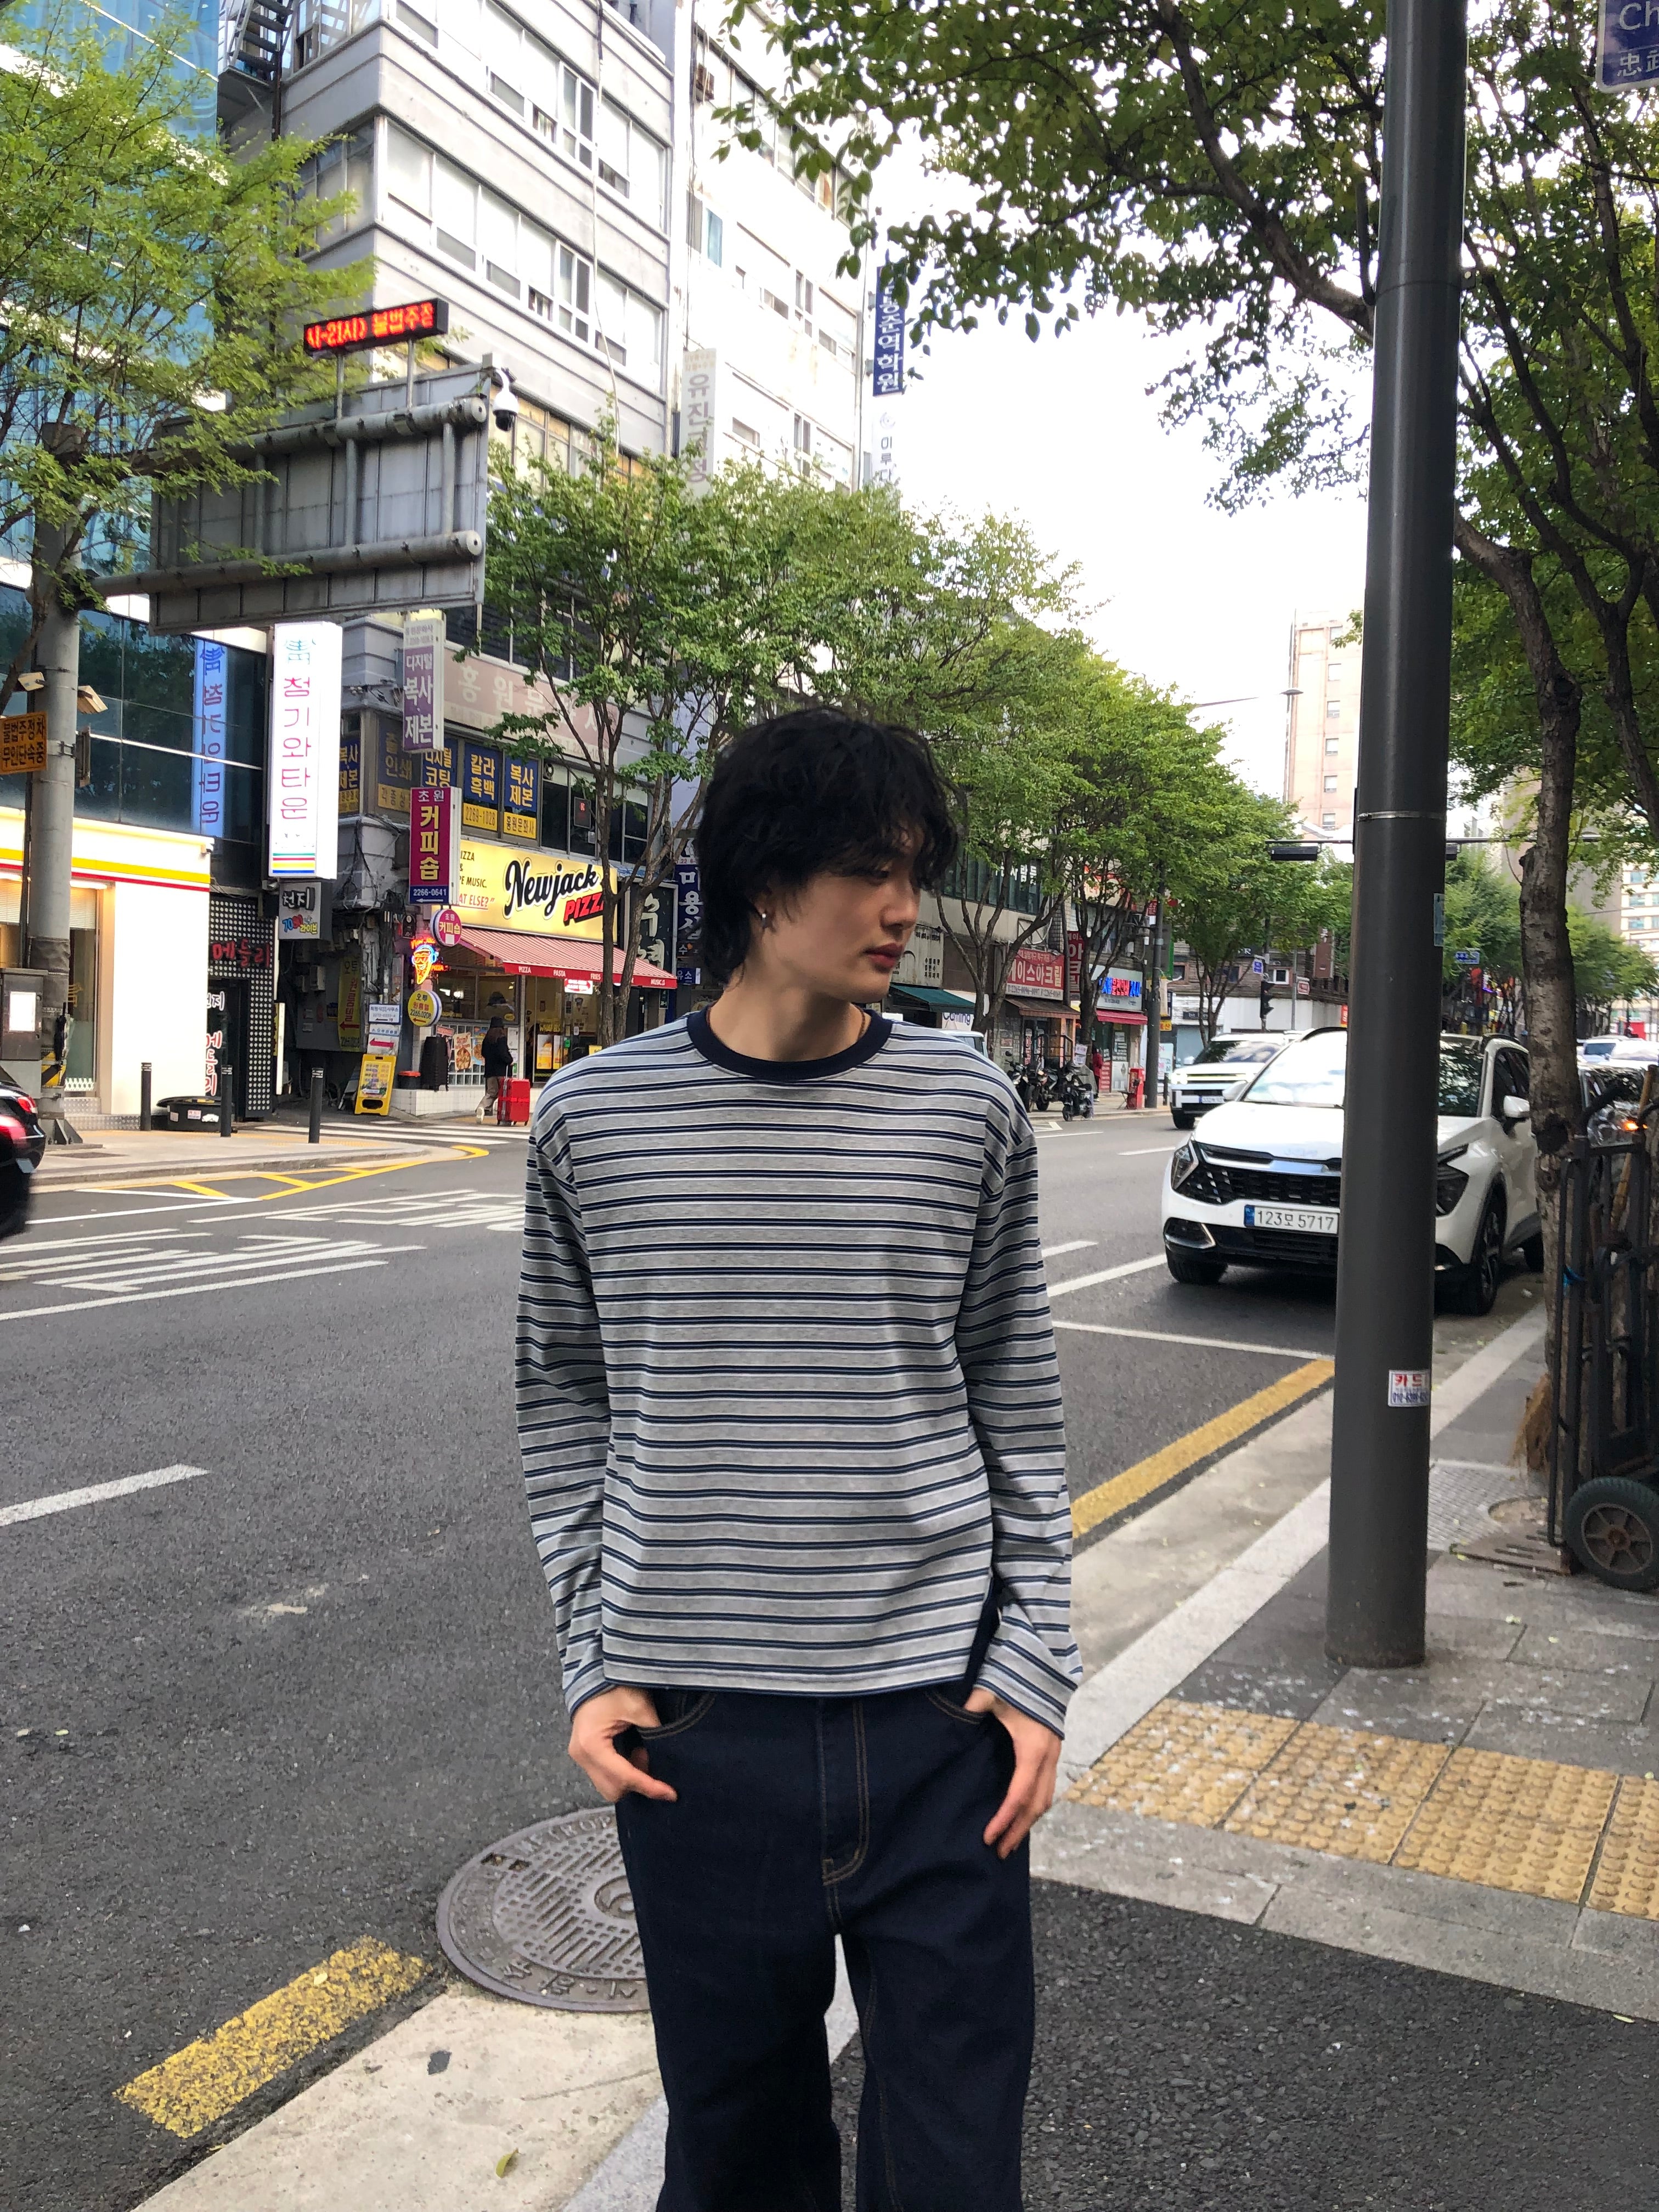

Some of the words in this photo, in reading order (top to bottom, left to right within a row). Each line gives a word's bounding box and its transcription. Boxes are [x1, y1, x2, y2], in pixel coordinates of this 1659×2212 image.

[406, 652, 432, 672] 디지털
[405, 675, 433, 706] 복사
[3, 715, 44, 744] 불법주정차
[405, 713, 433, 745] 제본
[2, 741, 44, 768] 무인단속중
[280, 676, 312, 820] 청기와타운
[425, 766, 450, 788] 코팅
[471, 753, 495, 779] 칼라
[510, 763, 534, 789] 복사
[418, 789, 444, 803] 초원
[471, 776, 495, 801] 흑백
[510, 785, 533, 808] 제본
[419, 805, 440, 881] 커피숍
[460, 850, 475, 861] IZZA
[283, 887, 312, 910] 천지
[413, 889, 447, 897] 2266-0641
[504, 859, 599, 917] Newjack
[563, 891, 603, 927] PIZZ
[678, 867, 704, 940] 미용실
[300, 923, 318, 935] 라이브
[439, 921, 461, 934] 커피숍
[212, 939, 271, 968] 메들리
[518, 966, 532, 974] PIZZA
[553, 969, 566, 977] PASTA
[1257, 1210, 1294, 1227] 123모
[1297, 1214, 1335, 1231] 5717
[1395, 1373, 1423, 1387] 카드
